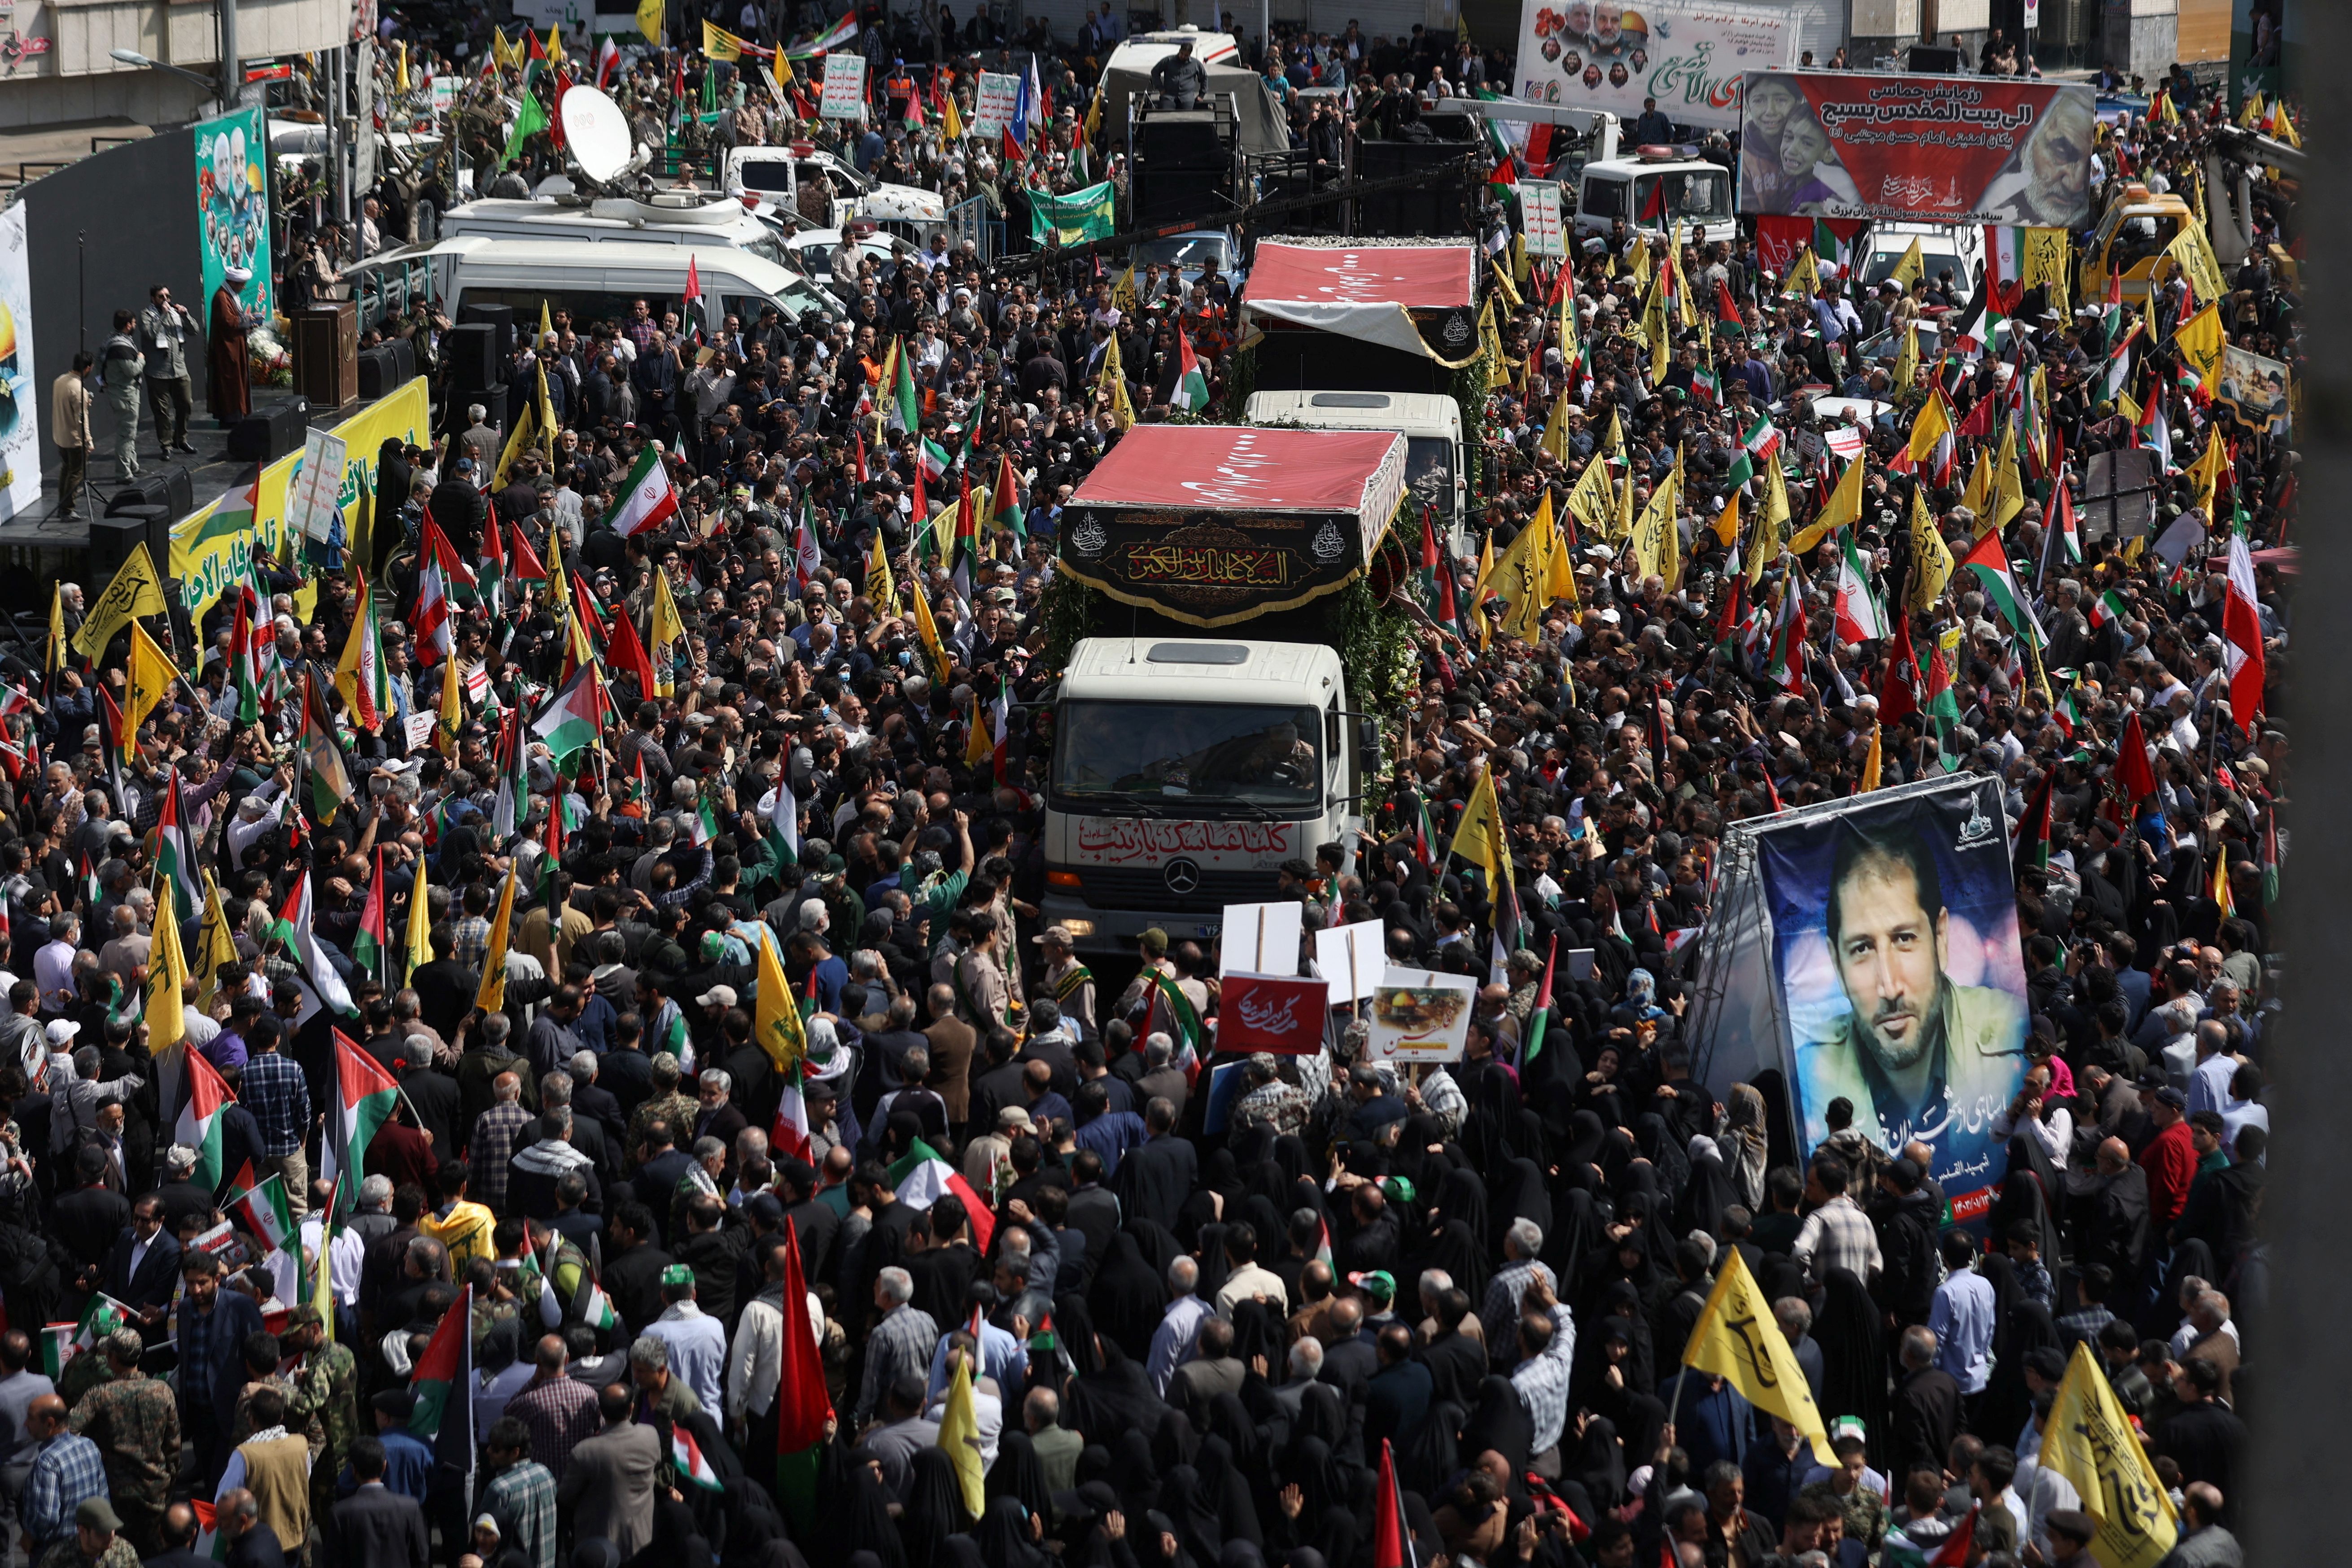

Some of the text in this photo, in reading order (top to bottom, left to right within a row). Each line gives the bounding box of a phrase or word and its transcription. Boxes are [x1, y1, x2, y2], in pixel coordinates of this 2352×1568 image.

[1869, 82, 1982, 105] رزمایش حماسی
[1462, 105, 1484, 114] TADANO
[1822, 100, 2033, 130] الی بیت المقدس بسیج
[1844, 128, 1885, 145] مجتبی
[1886, 130, 1919, 145] حسن
[1919, 131, 1945, 147] امام
[1945, 132, 1987, 149] امنیتی
[1987, 132, 2014, 150] یگان
[1831, 206, 2002, 224] سپاه حضرت محمد رسول الله تهران بزرگ
[1846, 430, 1858, 438] مرگ
[1231, 550, 1287, 586] السلام
[1079, 817, 1145, 862] زينب
[1159, 821, 1243, 862] عباسك
[1262, 993, 1301, 1035] مرگ
[1382, 1008, 1453, 1056] فلسطین
[1936, 1152, 1991, 1186] شهید القدس
[197, 1227, 227, 1245] YOU HAVE
